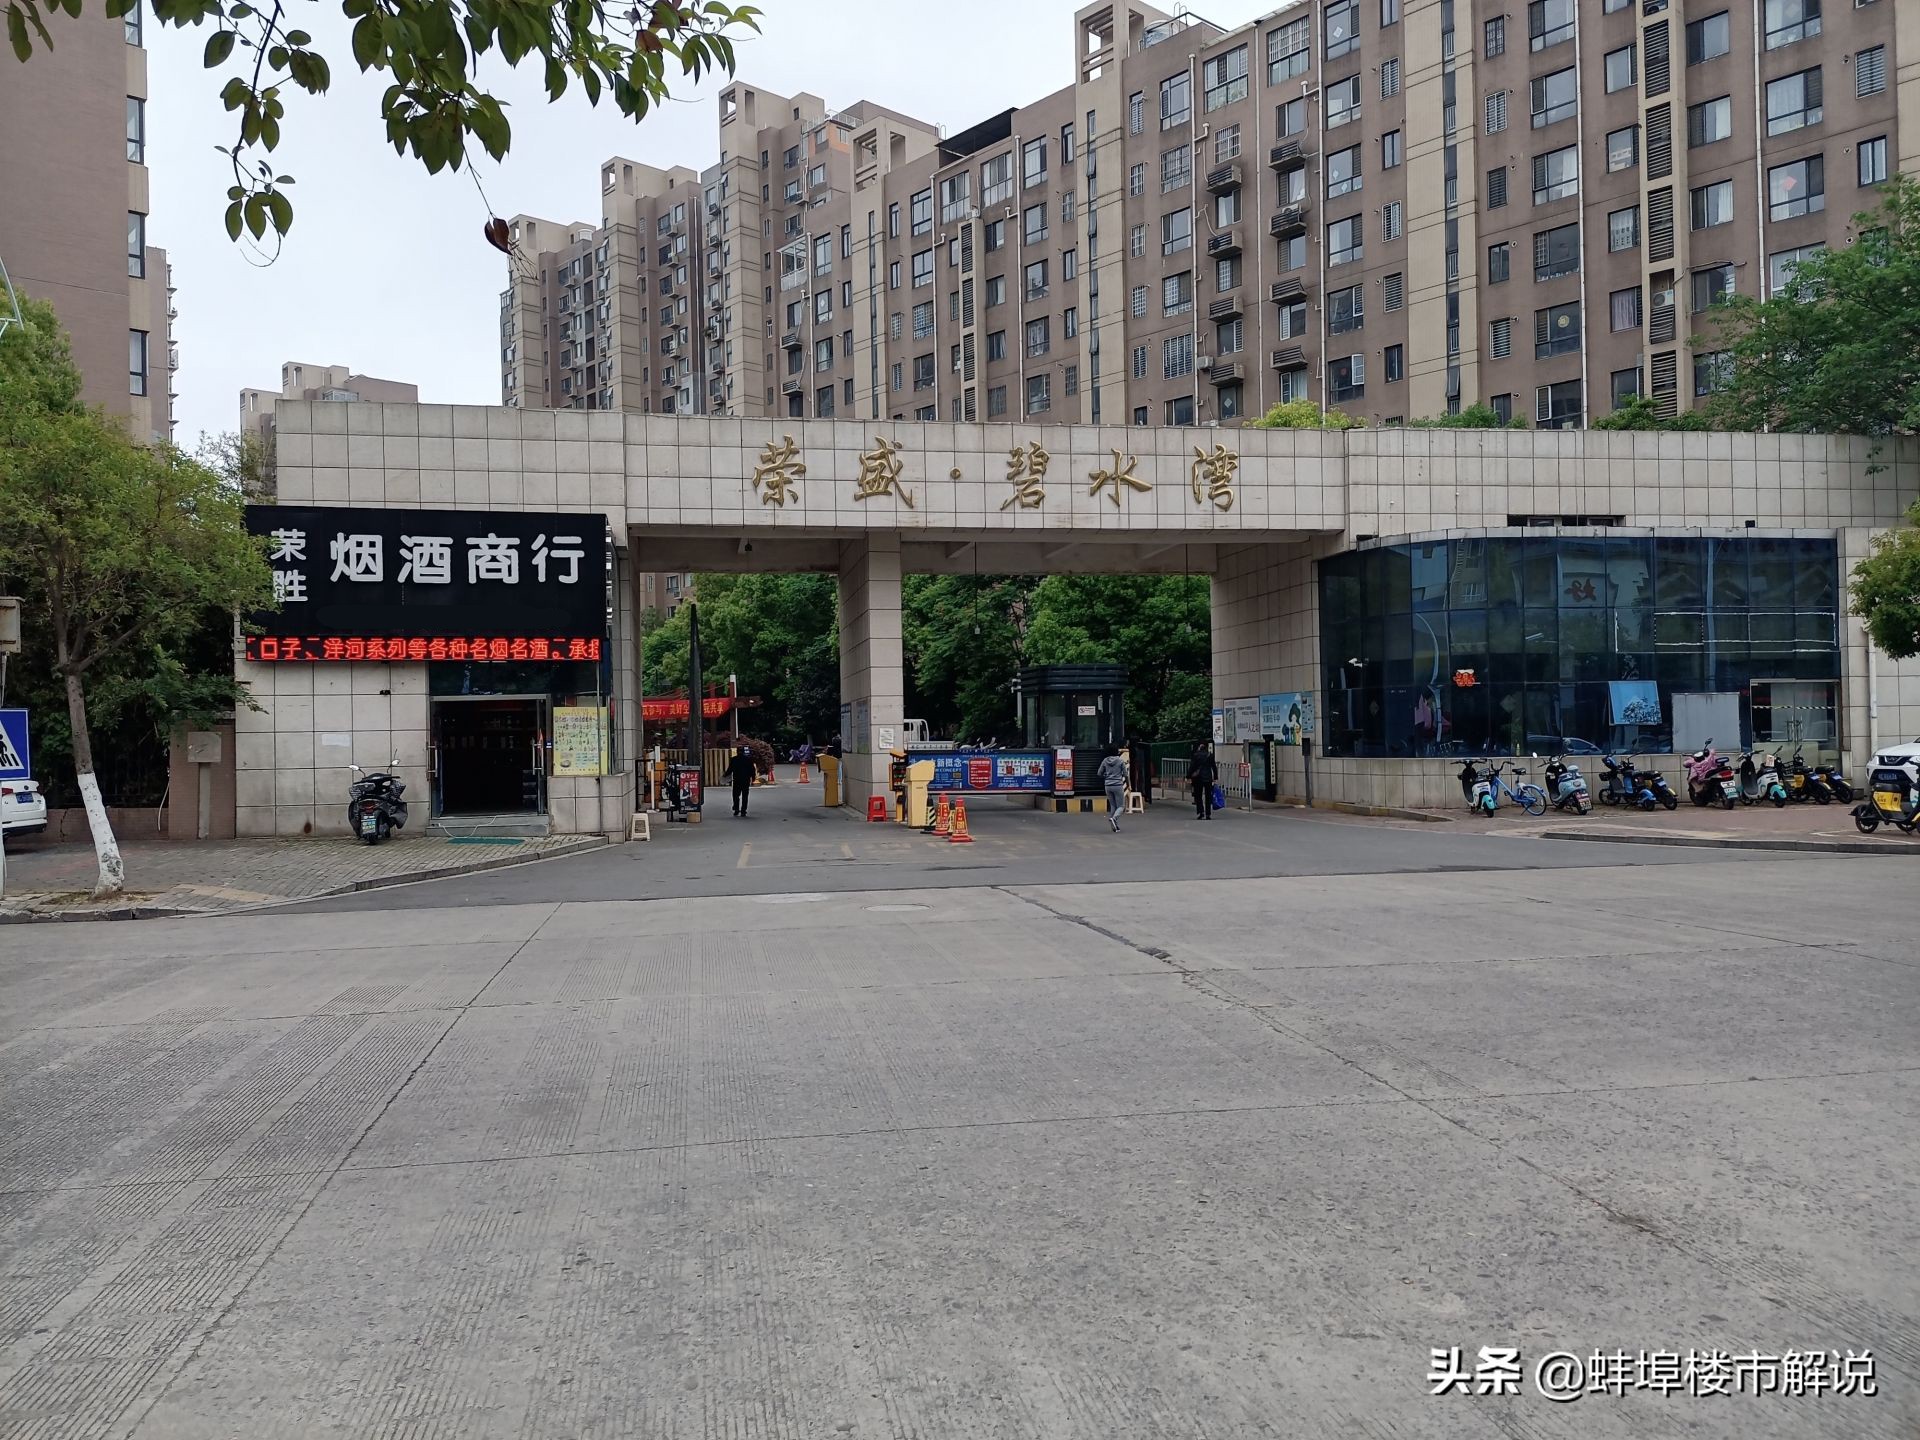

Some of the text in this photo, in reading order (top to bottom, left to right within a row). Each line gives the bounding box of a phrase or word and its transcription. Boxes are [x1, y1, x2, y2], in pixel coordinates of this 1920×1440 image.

[270, 528, 308, 602] 荣胜
[329, 532, 585, 585] 烟酒商行
